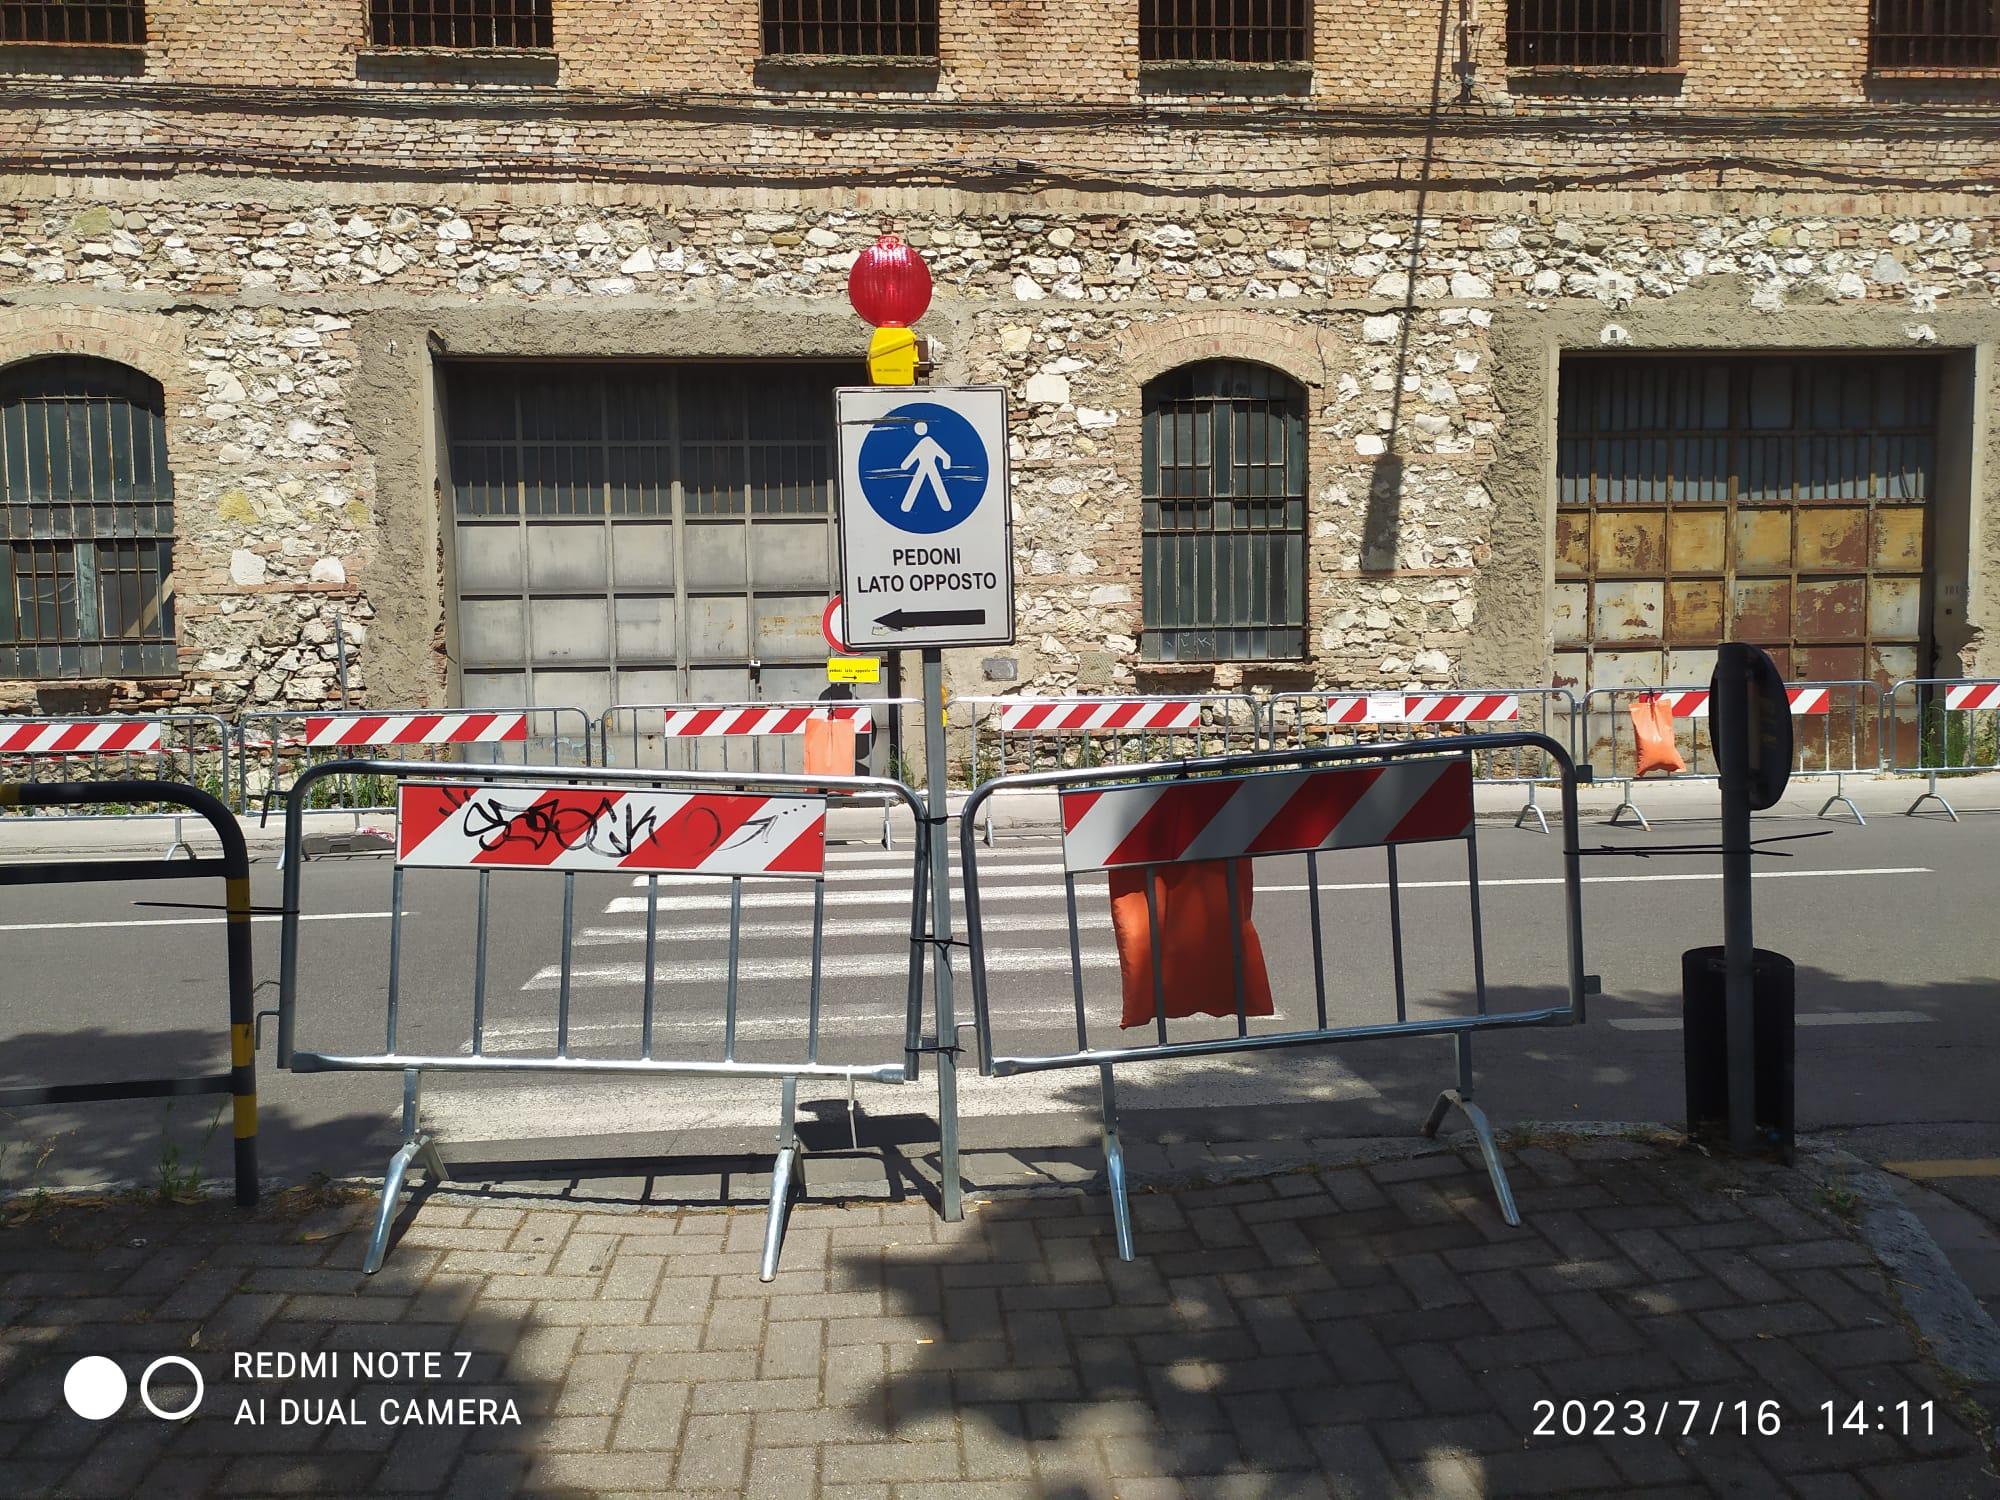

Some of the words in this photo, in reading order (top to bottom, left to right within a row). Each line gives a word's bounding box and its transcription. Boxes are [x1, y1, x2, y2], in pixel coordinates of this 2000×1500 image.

[893, 548, 961, 566] PEDONI
[858, 575, 904, 593] LATO
[910, 573, 997, 592] OPPOSTO
